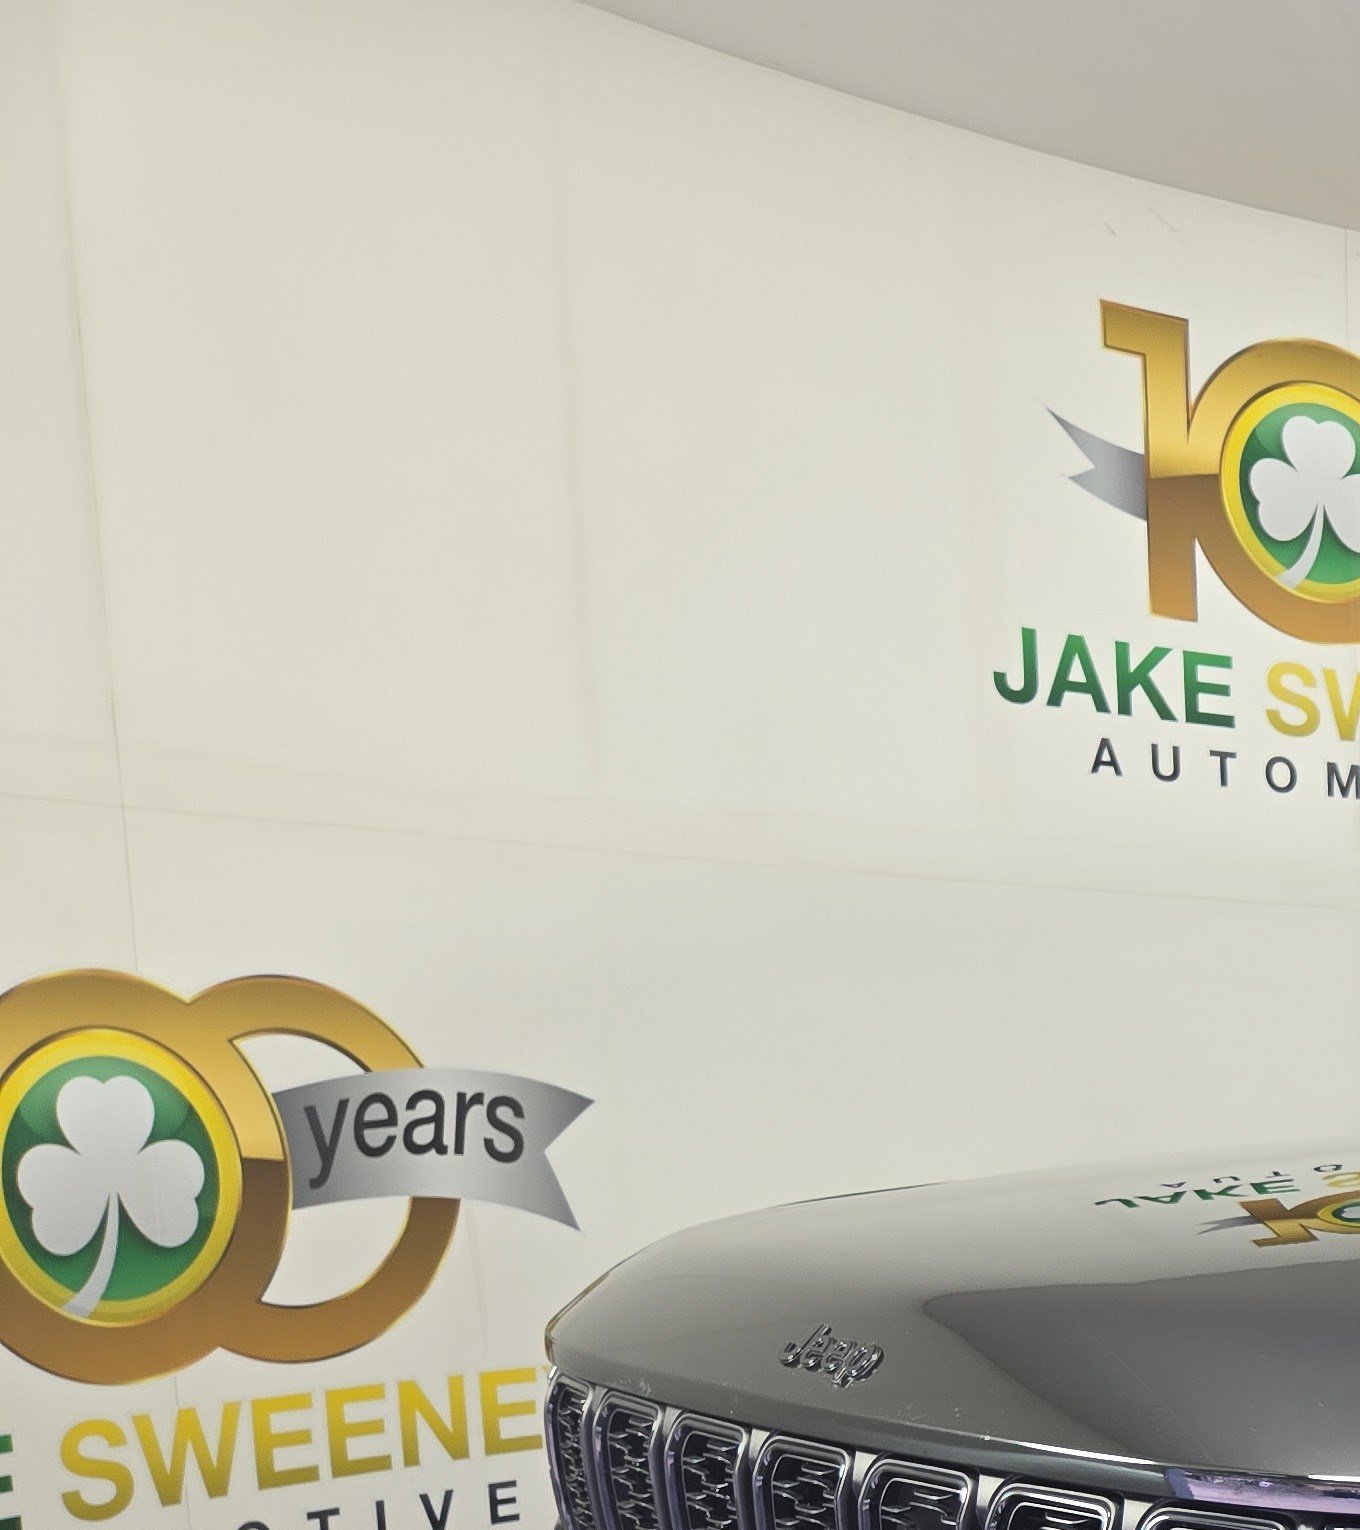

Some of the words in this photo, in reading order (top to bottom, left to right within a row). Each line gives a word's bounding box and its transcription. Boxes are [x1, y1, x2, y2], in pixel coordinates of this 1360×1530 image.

[992, 627, 1238, 729] JAKE
[304, 1088, 526, 1189] years
[779, 1323, 885, 1389] Jeep
[59, 1365, 556, 1521] SWEENE
